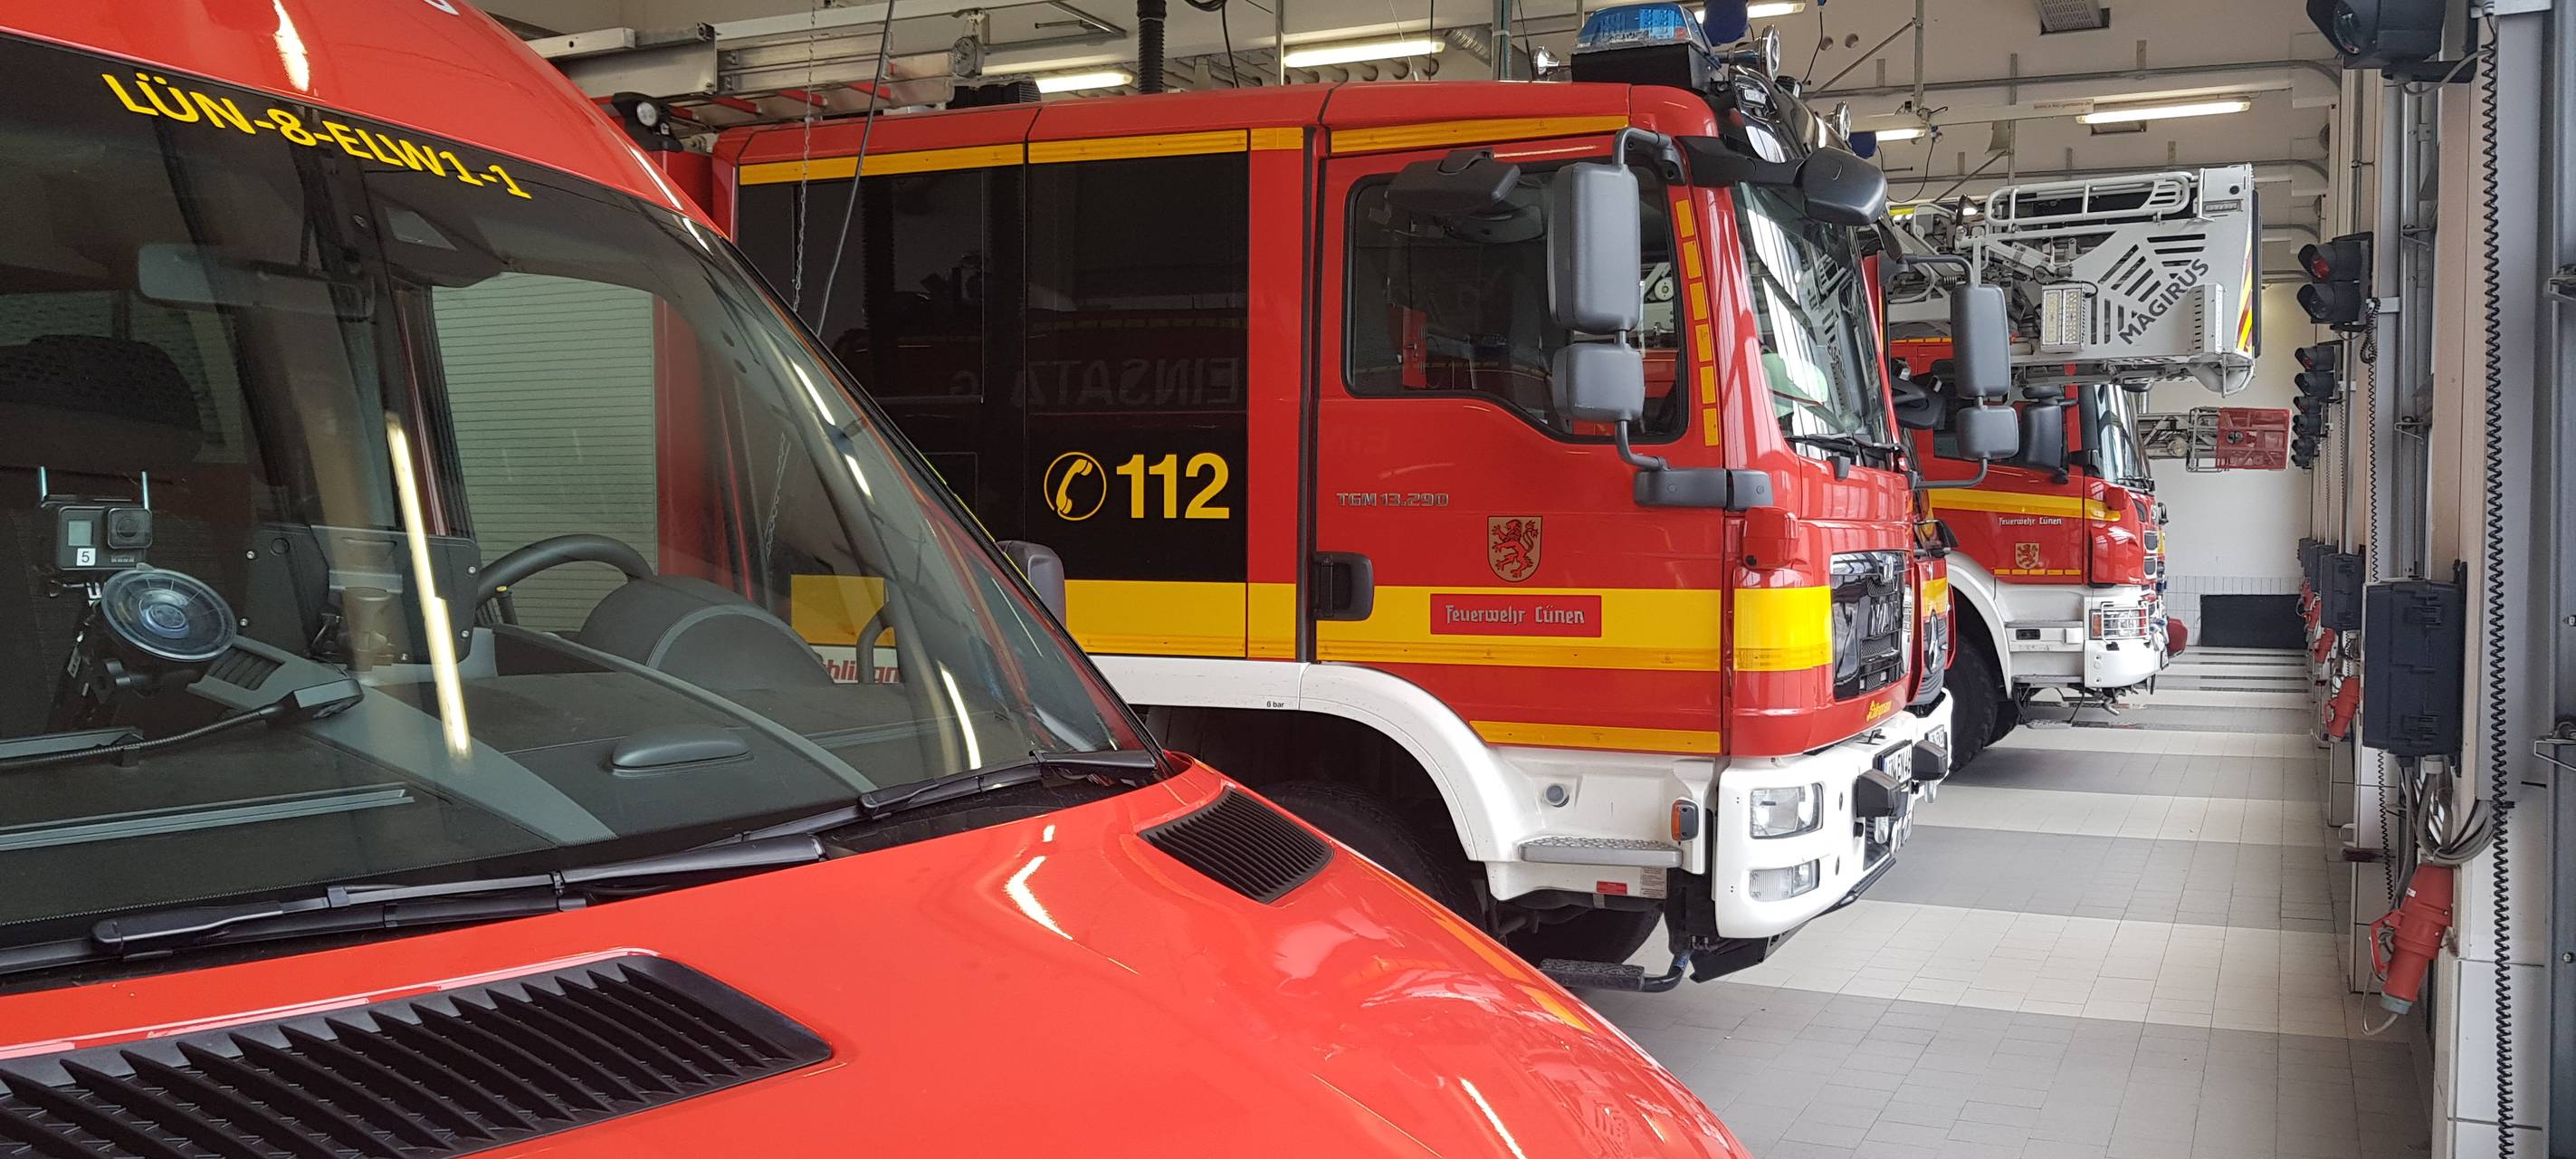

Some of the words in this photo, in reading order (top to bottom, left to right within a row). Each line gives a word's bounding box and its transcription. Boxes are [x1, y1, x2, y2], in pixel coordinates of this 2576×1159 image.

[102, 72, 532, 199] LÜN-8-ELW1-1
[2118, 258, 2209, 345] MAGIRUS
[1116, 452, 1230, 519] 112
[1336, 493, 1377, 506] TGM
[1380, 493, 1449, 506] 13.290
[1999, 517, 2036, 526] Feuerwehr
[81, 551, 90, 563] 5
[1445, 604, 1527, 627] Feuerwehr
